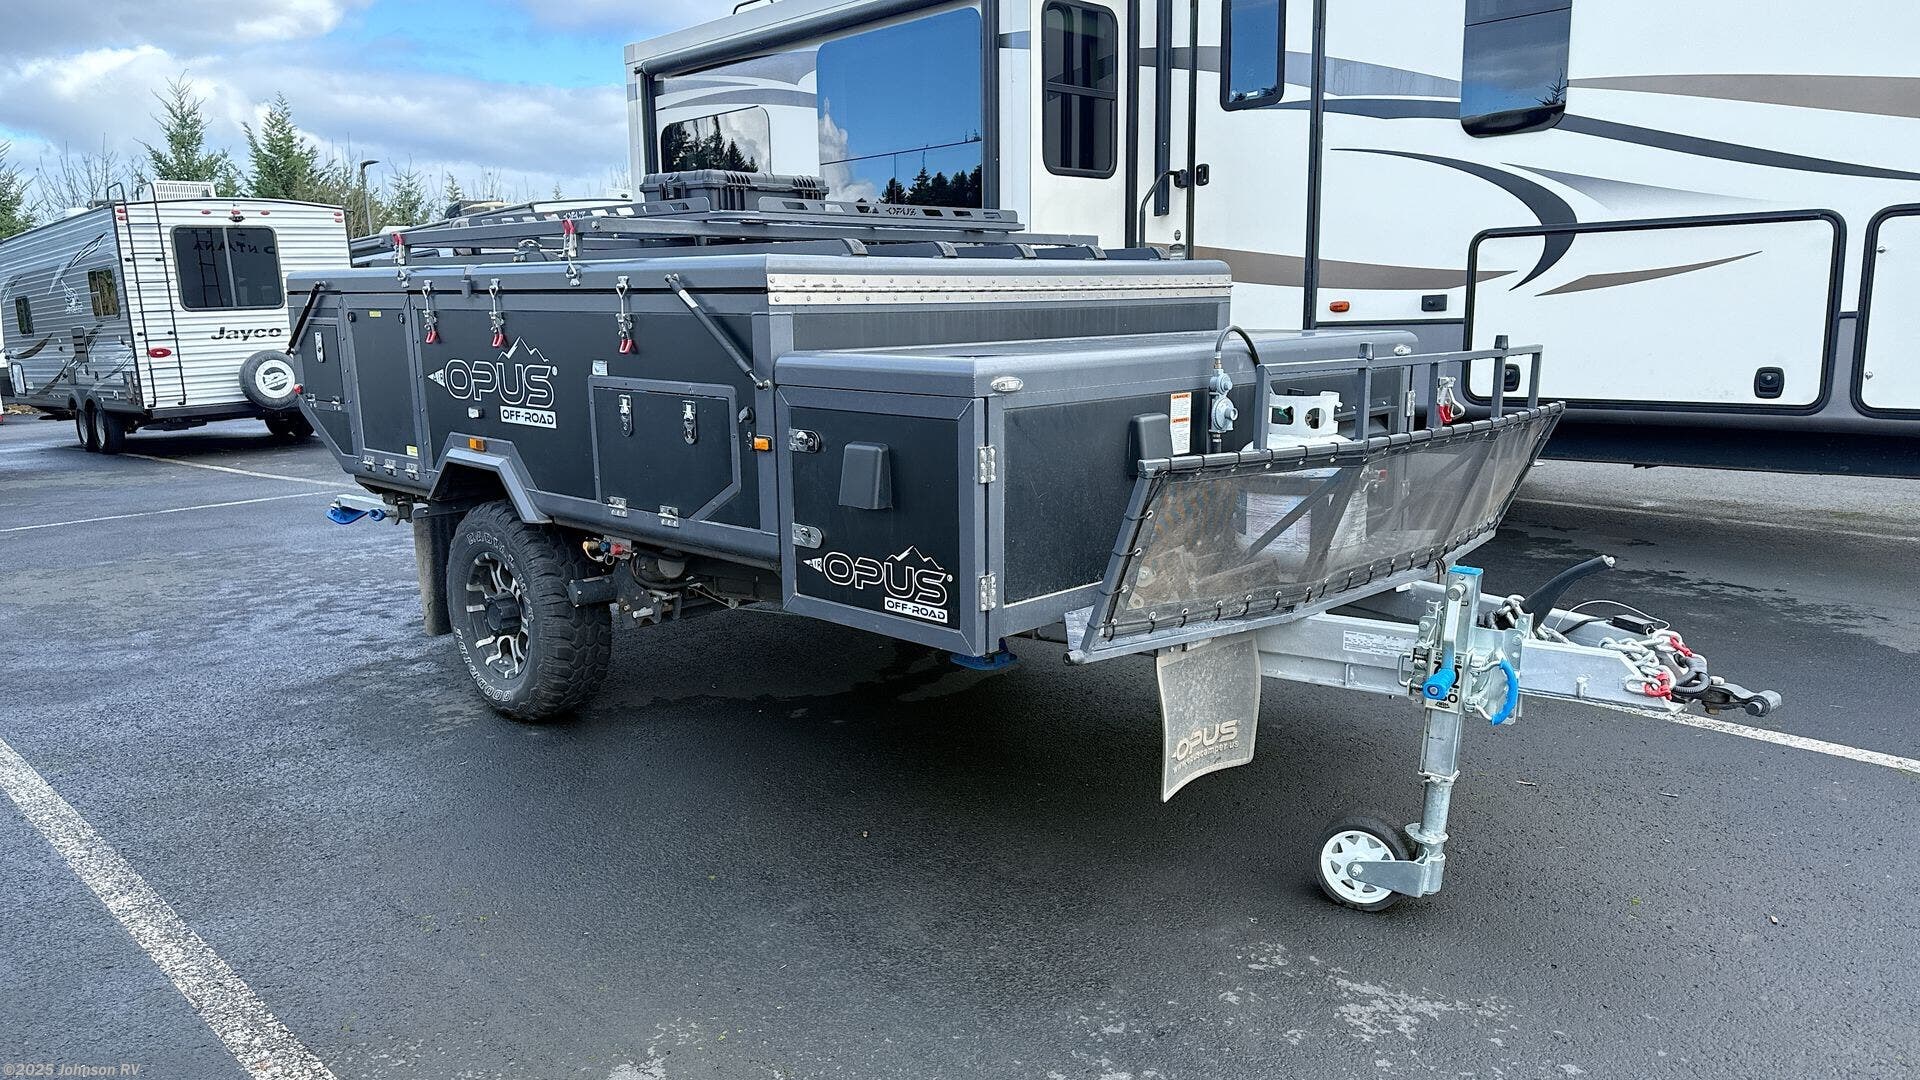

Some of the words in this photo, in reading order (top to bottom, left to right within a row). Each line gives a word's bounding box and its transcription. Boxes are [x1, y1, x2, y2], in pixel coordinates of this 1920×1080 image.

[211, 327, 282, 341] Jayco
[445, 359, 554, 408] OPUS
[502, 409, 554, 425] OFF-ROAD
[823, 551, 948, 606] OPUS
[886, 600, 946, 621] OFF-ROAD
[1176, 719, 1239, 761] OPUS
